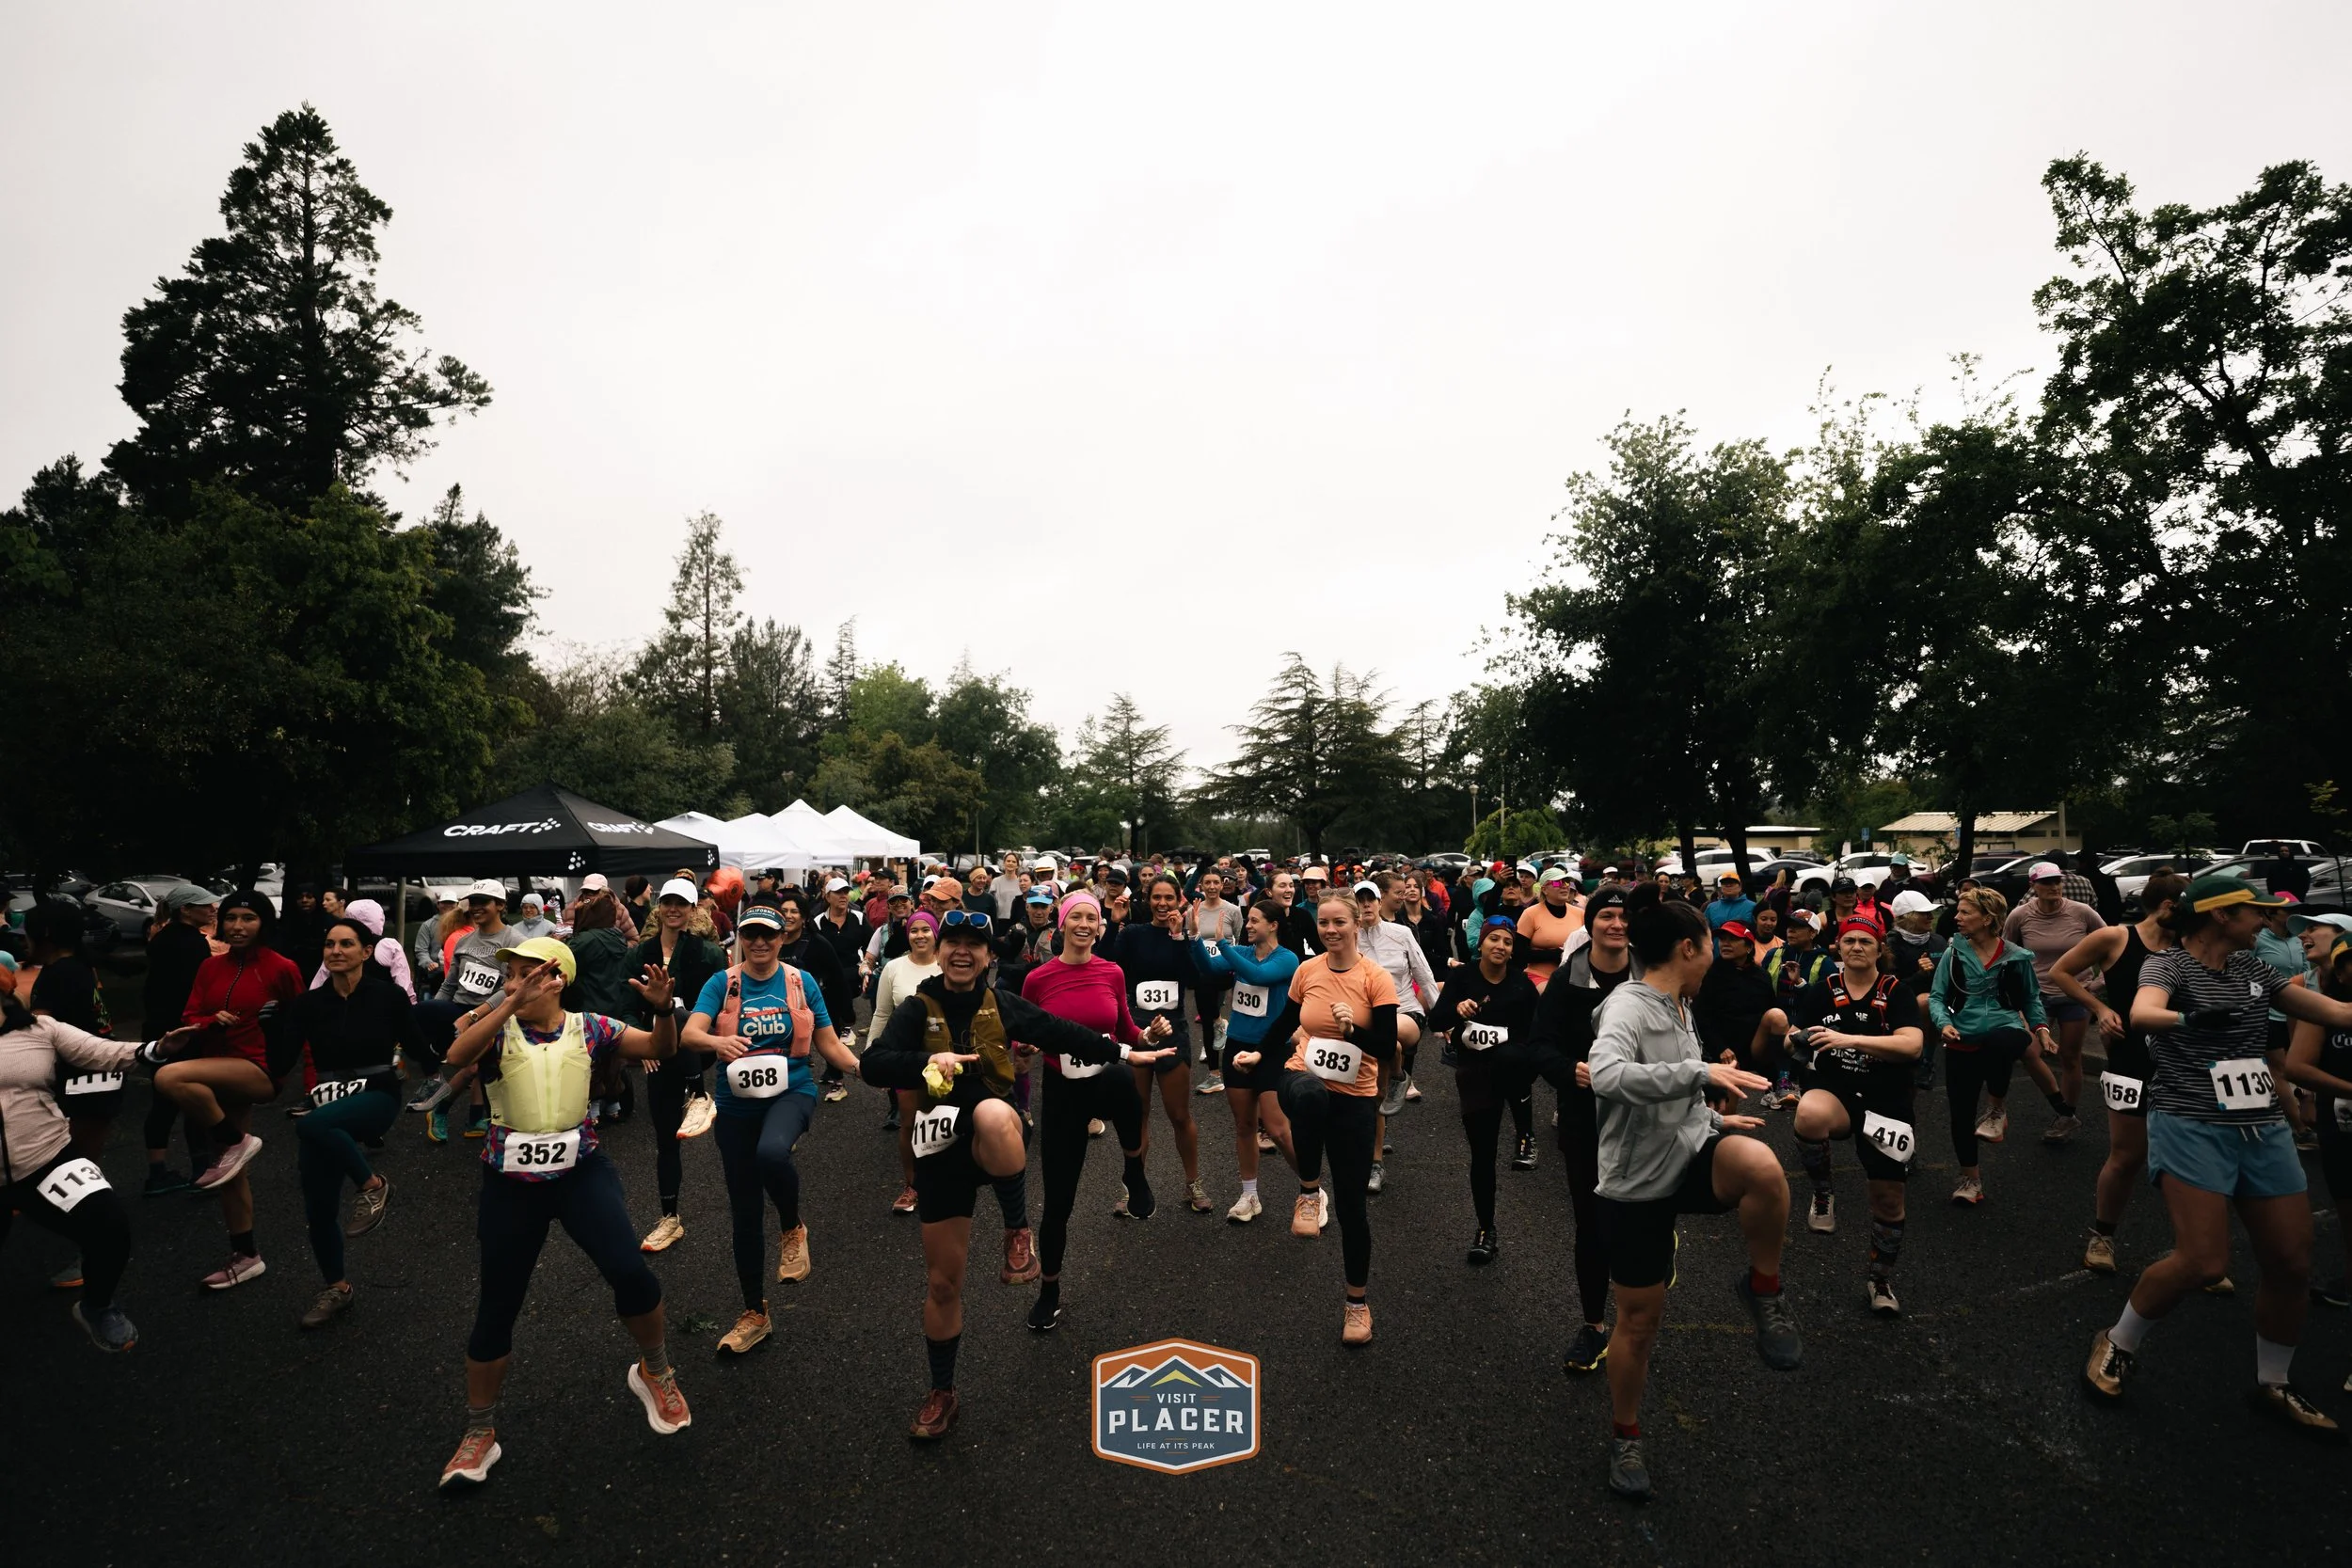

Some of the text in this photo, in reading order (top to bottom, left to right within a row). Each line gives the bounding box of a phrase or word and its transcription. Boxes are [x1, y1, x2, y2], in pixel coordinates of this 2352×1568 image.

[443, 821, 540, 837] CRAFT
[587, 821, 641, 833] CRAFT
[1205, 946, 1217, 956] 30
[463, 969, 496, 989] 1186
[1144, 990, 1169, 1003] 331
[1237, 991, 1261, 1008] 330
[742, 1021, 787, 1037] Club
[1469, 1030, 1499, 1045] 403
[1313, 1049, 1351, 1072] 383
[738, 1068, 778, 1088] 368
[2217, 1070, 2276, 1097] 1130
[313, 1081, 363, 1103] 1182
[914, 1117, 953, 1146] 1179
[1873, 1126, 1910, 1152] 416
[516, 1141, 567, 1165] 352
[48, 1166, 103, 1198] 113
